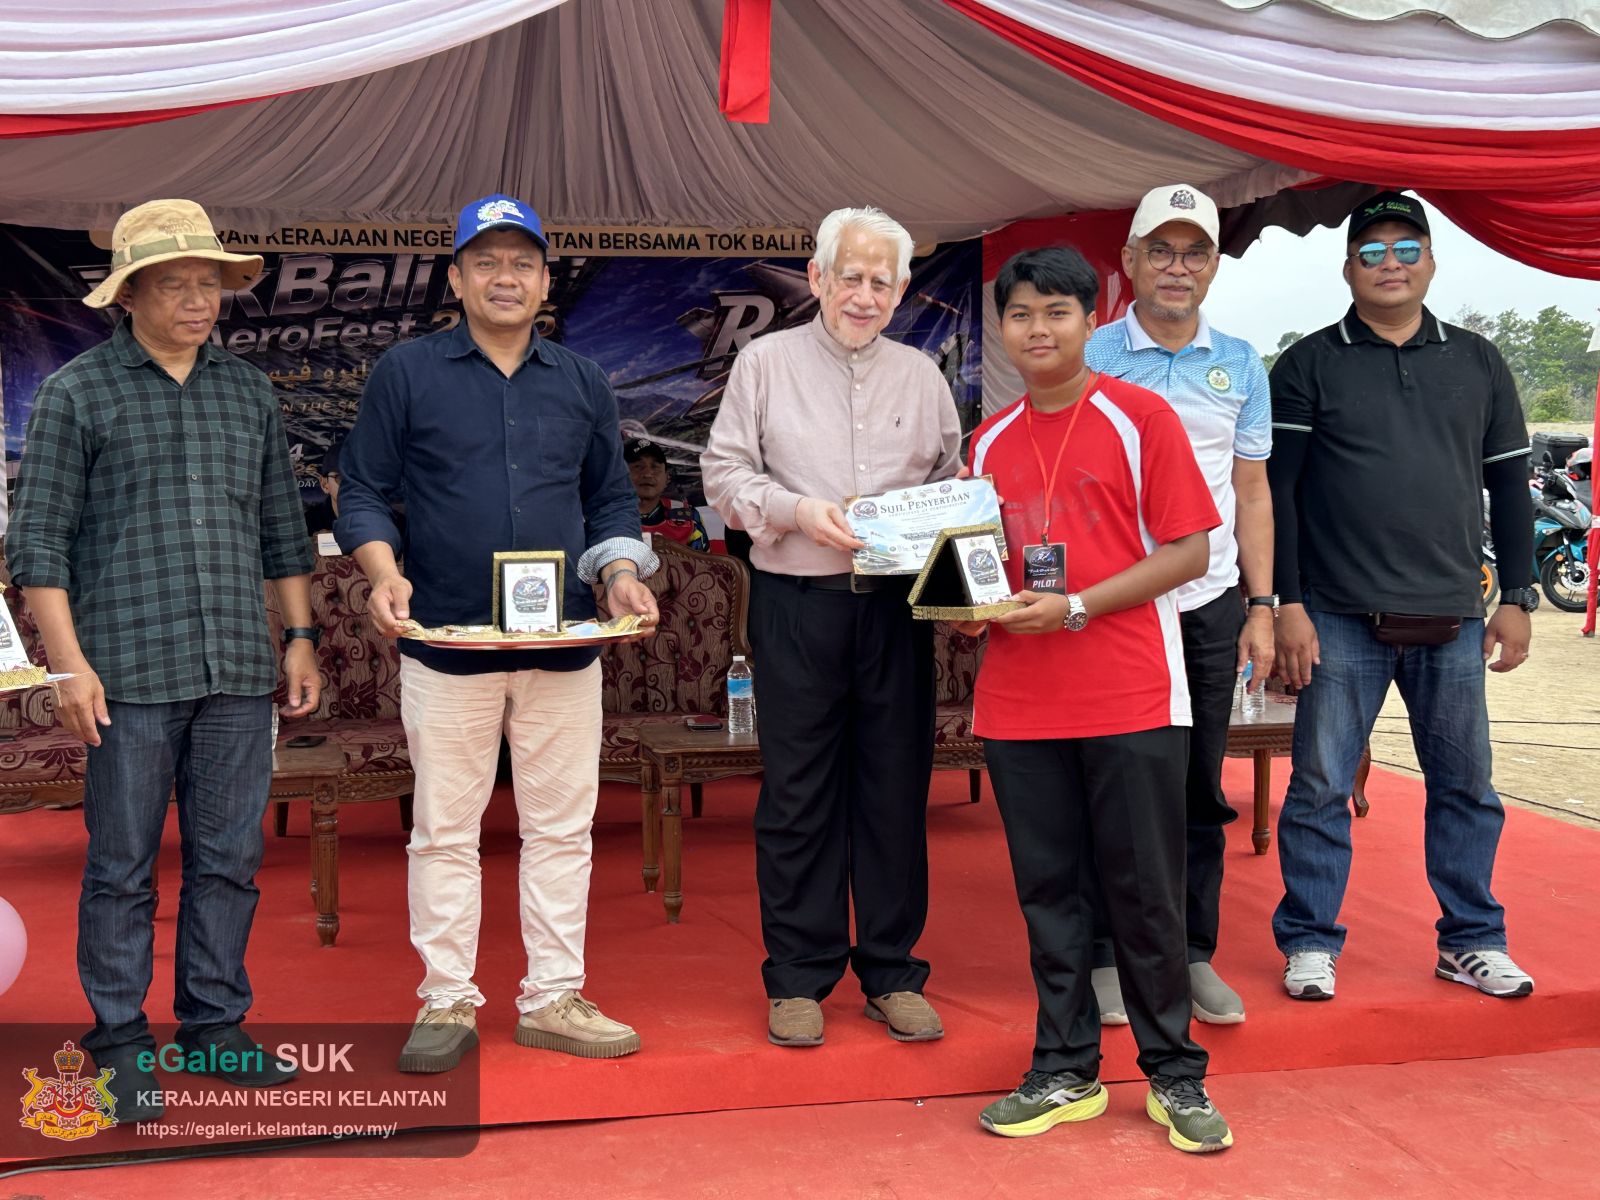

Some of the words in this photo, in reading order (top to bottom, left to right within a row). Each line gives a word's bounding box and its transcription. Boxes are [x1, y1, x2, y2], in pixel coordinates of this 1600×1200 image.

[266, 228, 387, 247] KERAJAAN
[394, 229, 457, 248] NEGE
[600, 232, 700, 250] BERSAMA
[705, 233, 747, 251] TOK
[752, 233, 796, 251] BALI
[801, 234, 817, 251] R
[908, 492, 970, 510] PENYERTAAN
[1032, 579, 1057, 589] PILOT
